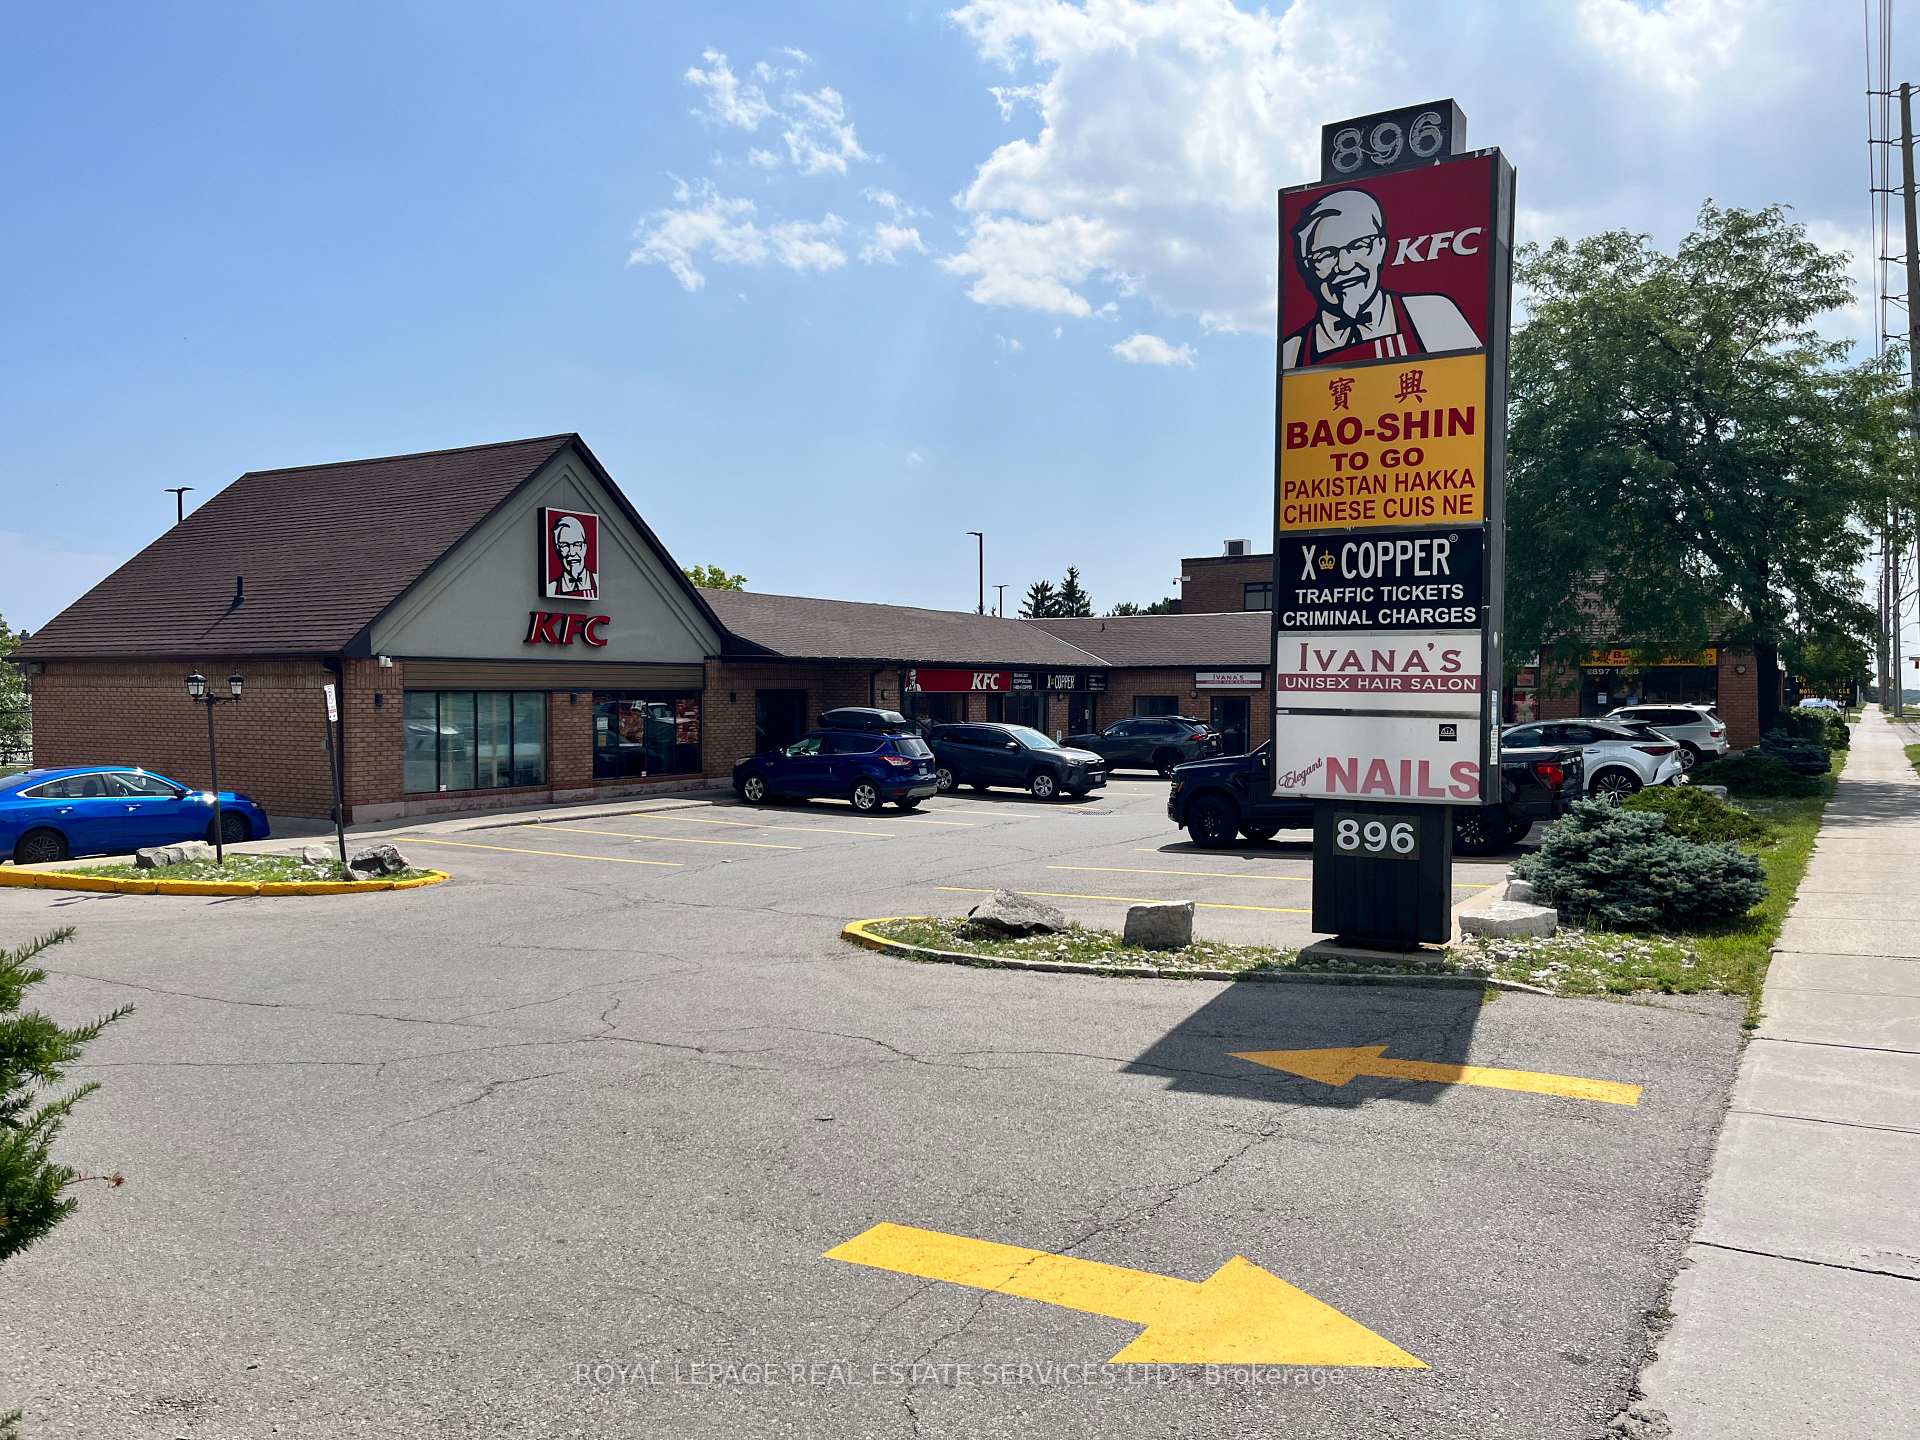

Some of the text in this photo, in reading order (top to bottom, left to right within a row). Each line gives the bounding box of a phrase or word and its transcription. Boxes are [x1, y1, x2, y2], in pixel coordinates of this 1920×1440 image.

[1332, 111, 1443, 173] 896
[1391, 226, 1482, 266] KFC
[1286, 406, 1475, 450] BAO-SHIN
[1329, 447, 1425, 471] TO GO
[1284, 468, 1476, 500] PAKISTAN HAKKA
[1283, 499, 1376, 524] CHINESE
[1301, 545, 1317, 581] X
[1296, 583, 1464, 604] TRAFFIC TICKETS
[523, 611, 611, 647] KFC
[1282, 606, 1477, 627] CRIMINAL CHARGES
[971, 672, 1000, 690] KFC
[1054, 674, 1075, 689] COPPER
[1285, 677, 1477, 691] UNISEX HAIR SALON
[1279, 757, 1480, 799] Elegant NAILS
[1336, 819, 1415, 854] 896
